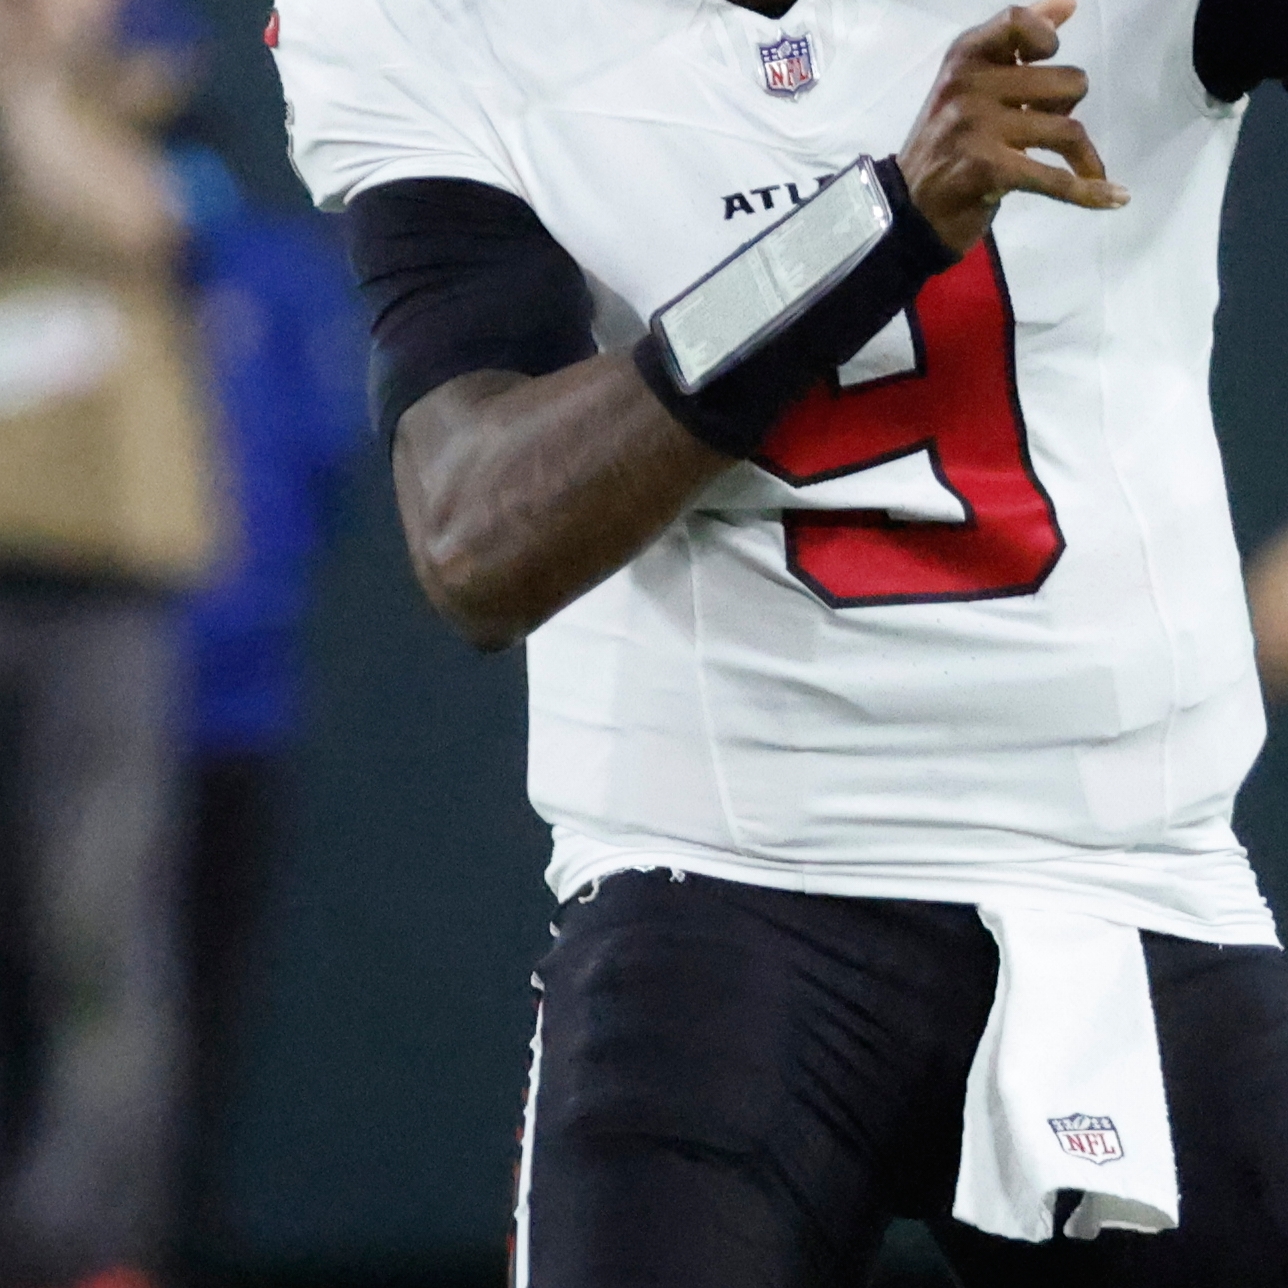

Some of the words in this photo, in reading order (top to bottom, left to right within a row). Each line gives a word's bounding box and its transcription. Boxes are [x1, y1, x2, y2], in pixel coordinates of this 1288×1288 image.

[766, 57, 810, 87] NFL
[721, 173, 836, 220] ATL
[748, 227, 1066, 609] 9
[1064, 1132, 1117, 1157] NFL
